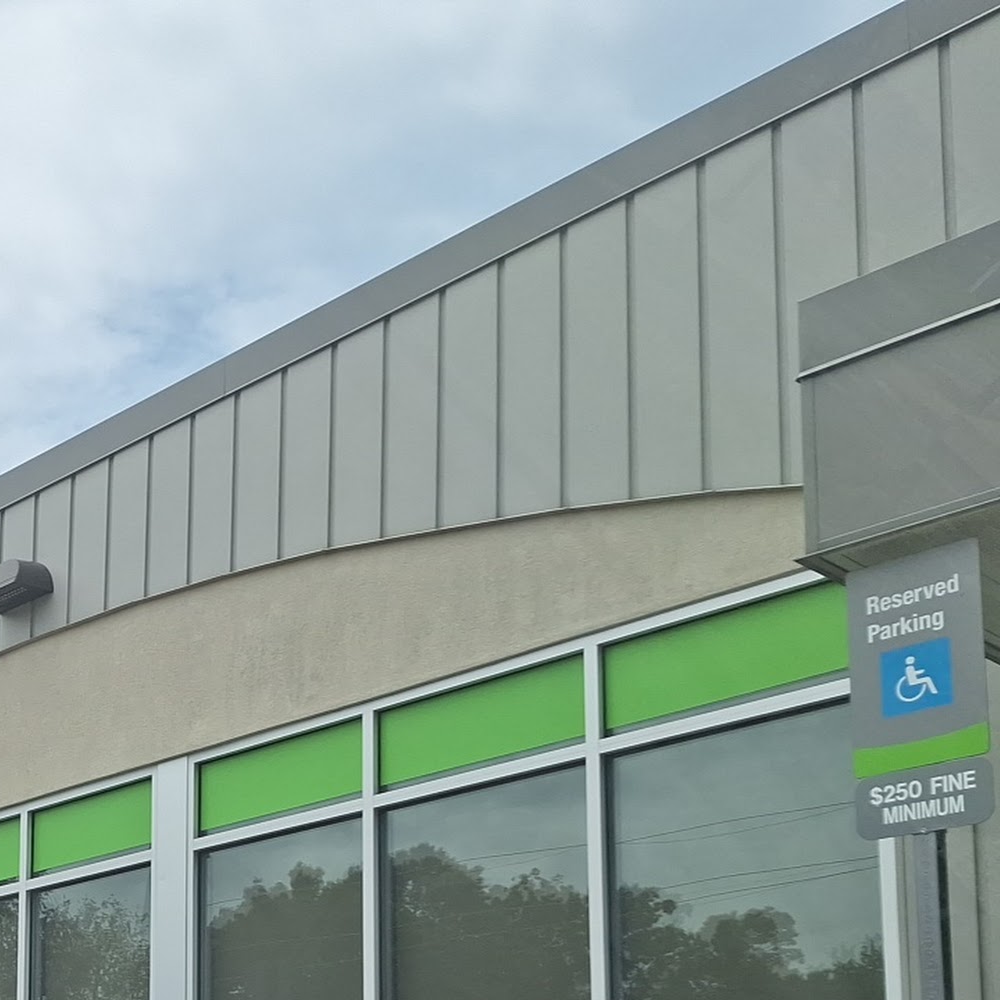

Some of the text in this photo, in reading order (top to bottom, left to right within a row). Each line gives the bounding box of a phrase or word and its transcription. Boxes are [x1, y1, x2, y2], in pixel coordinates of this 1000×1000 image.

[866, 573, 960, 616] Reserved
[867, 610, 945, 644] Parking
[869, 770, 977, 806] $250 FINE
[882, 794, 965, 825] MINIMUM
